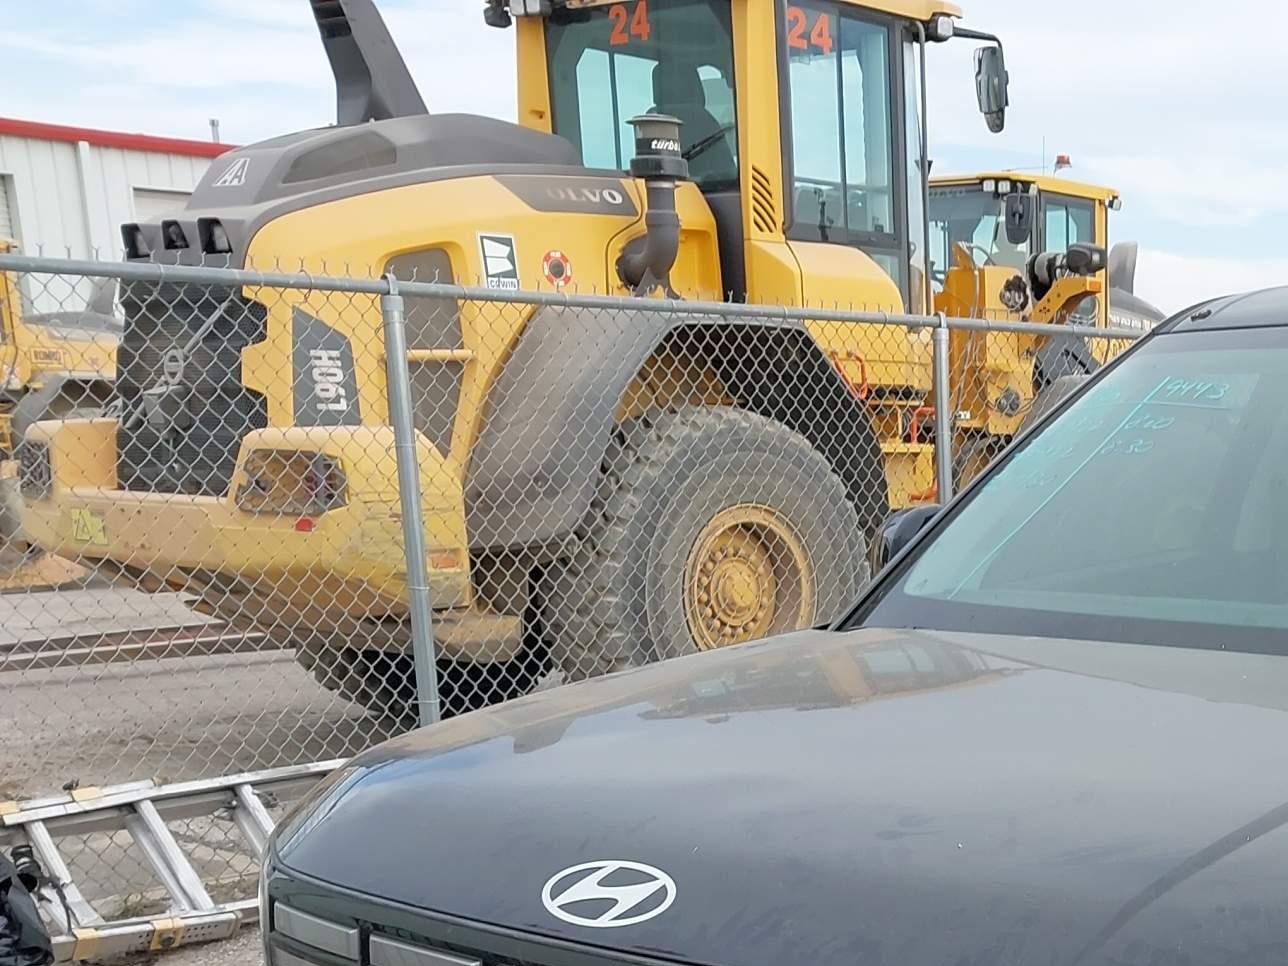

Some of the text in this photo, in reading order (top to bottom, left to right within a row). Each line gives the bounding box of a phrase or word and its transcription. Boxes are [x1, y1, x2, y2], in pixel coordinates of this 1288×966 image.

[608, 0, 651, 45] 24
[785, 6, 833, 55] 24
[545, 186, 624, 205] OLVO
[309, 349, 348, 411] L90H
